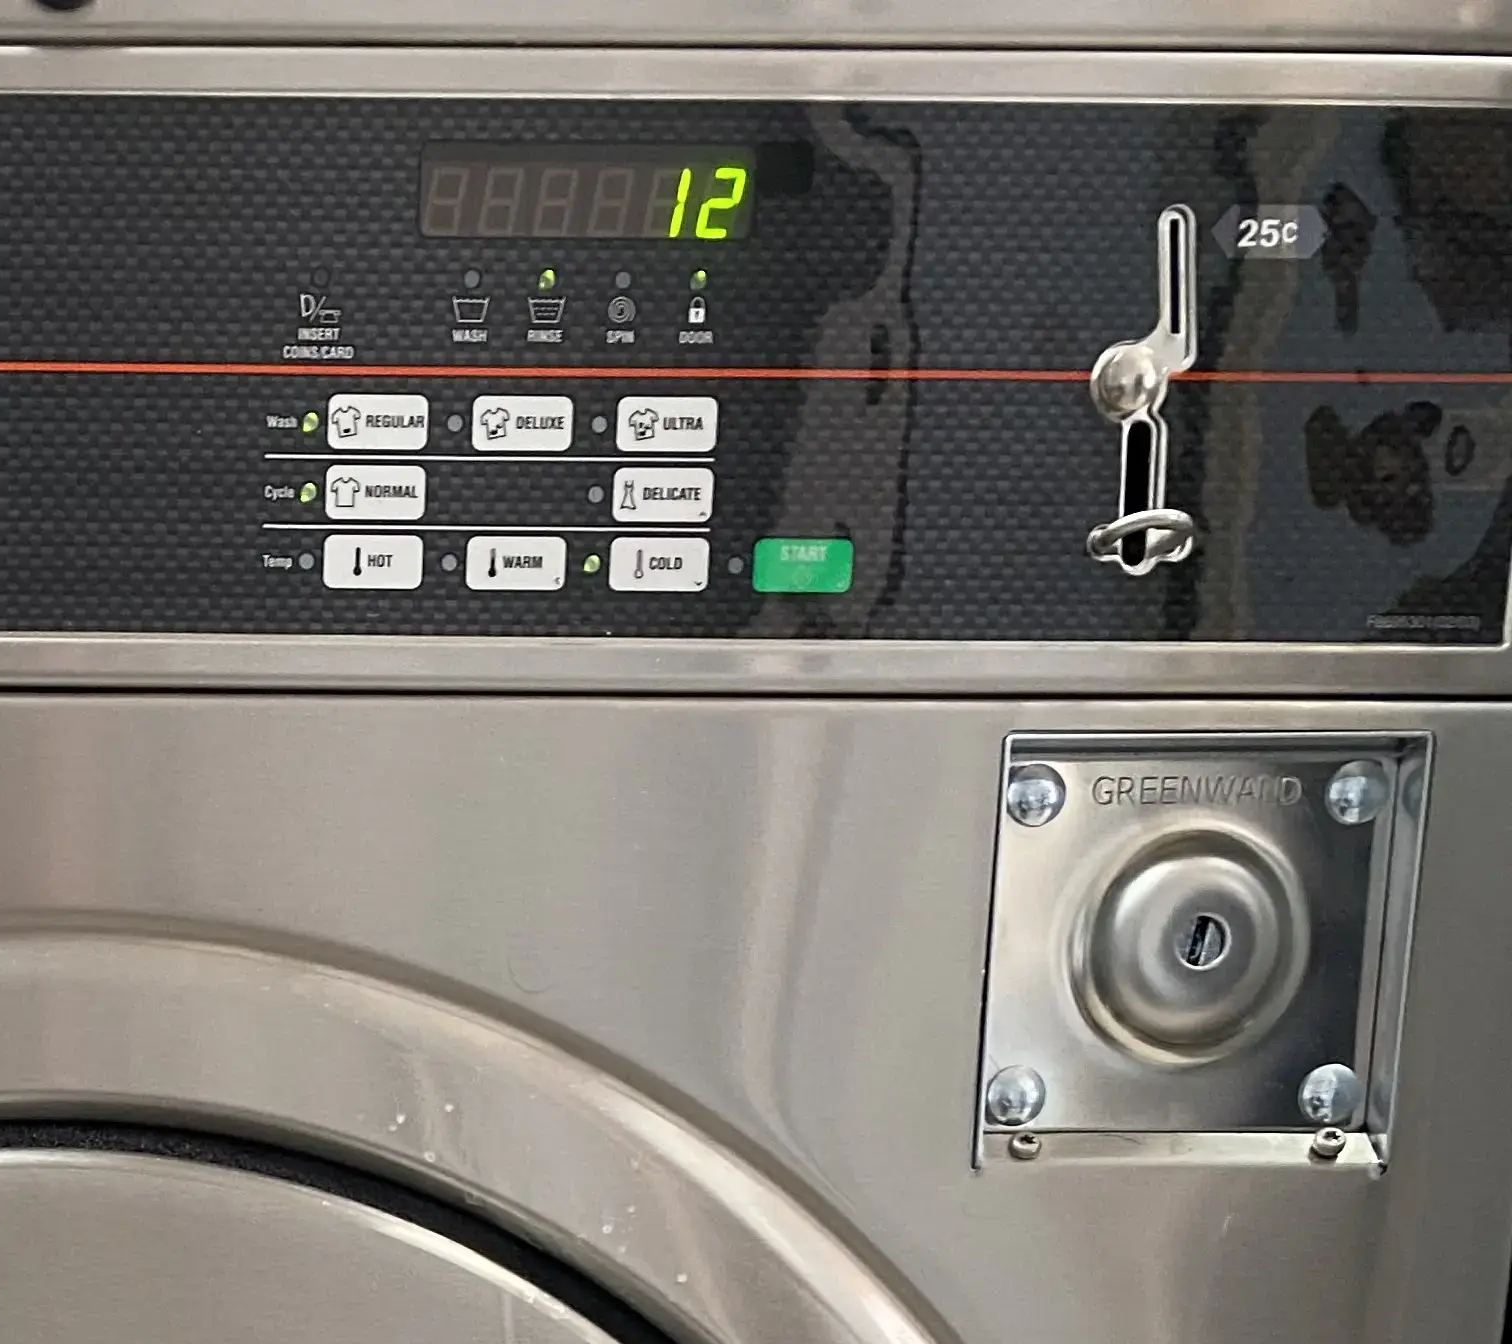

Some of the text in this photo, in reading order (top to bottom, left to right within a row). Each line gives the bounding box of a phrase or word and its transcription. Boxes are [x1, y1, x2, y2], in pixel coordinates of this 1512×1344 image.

[669, 167, 747, 239] 12
[298, 328, 340, 342] INSERT
[453, 330, 488, 343] WASH
[528, 330, 564, 344] RINSE
[606, 331, 635, 344] SPIN
[679, 331, 714, 345] DOOR
[266, 415, 299, 429] Wash
[366, 414, 425, 429] REGULAR
[515, 416, 565, 430] DELUXE
[663, 416, 704, 431] ULTRA
[264, 485, 296, 500] Cycle
[364, 485, 419, 499] NORMAL
[642, 487, 702, 501] DELICATE
[779, 545, 828, 562] START
[262, 554, 293, 570] Temp
[367, 554, 394, 568] HOT
[502, 555, 544, 569] WARM
[648, 556, 684, 571] COLD
